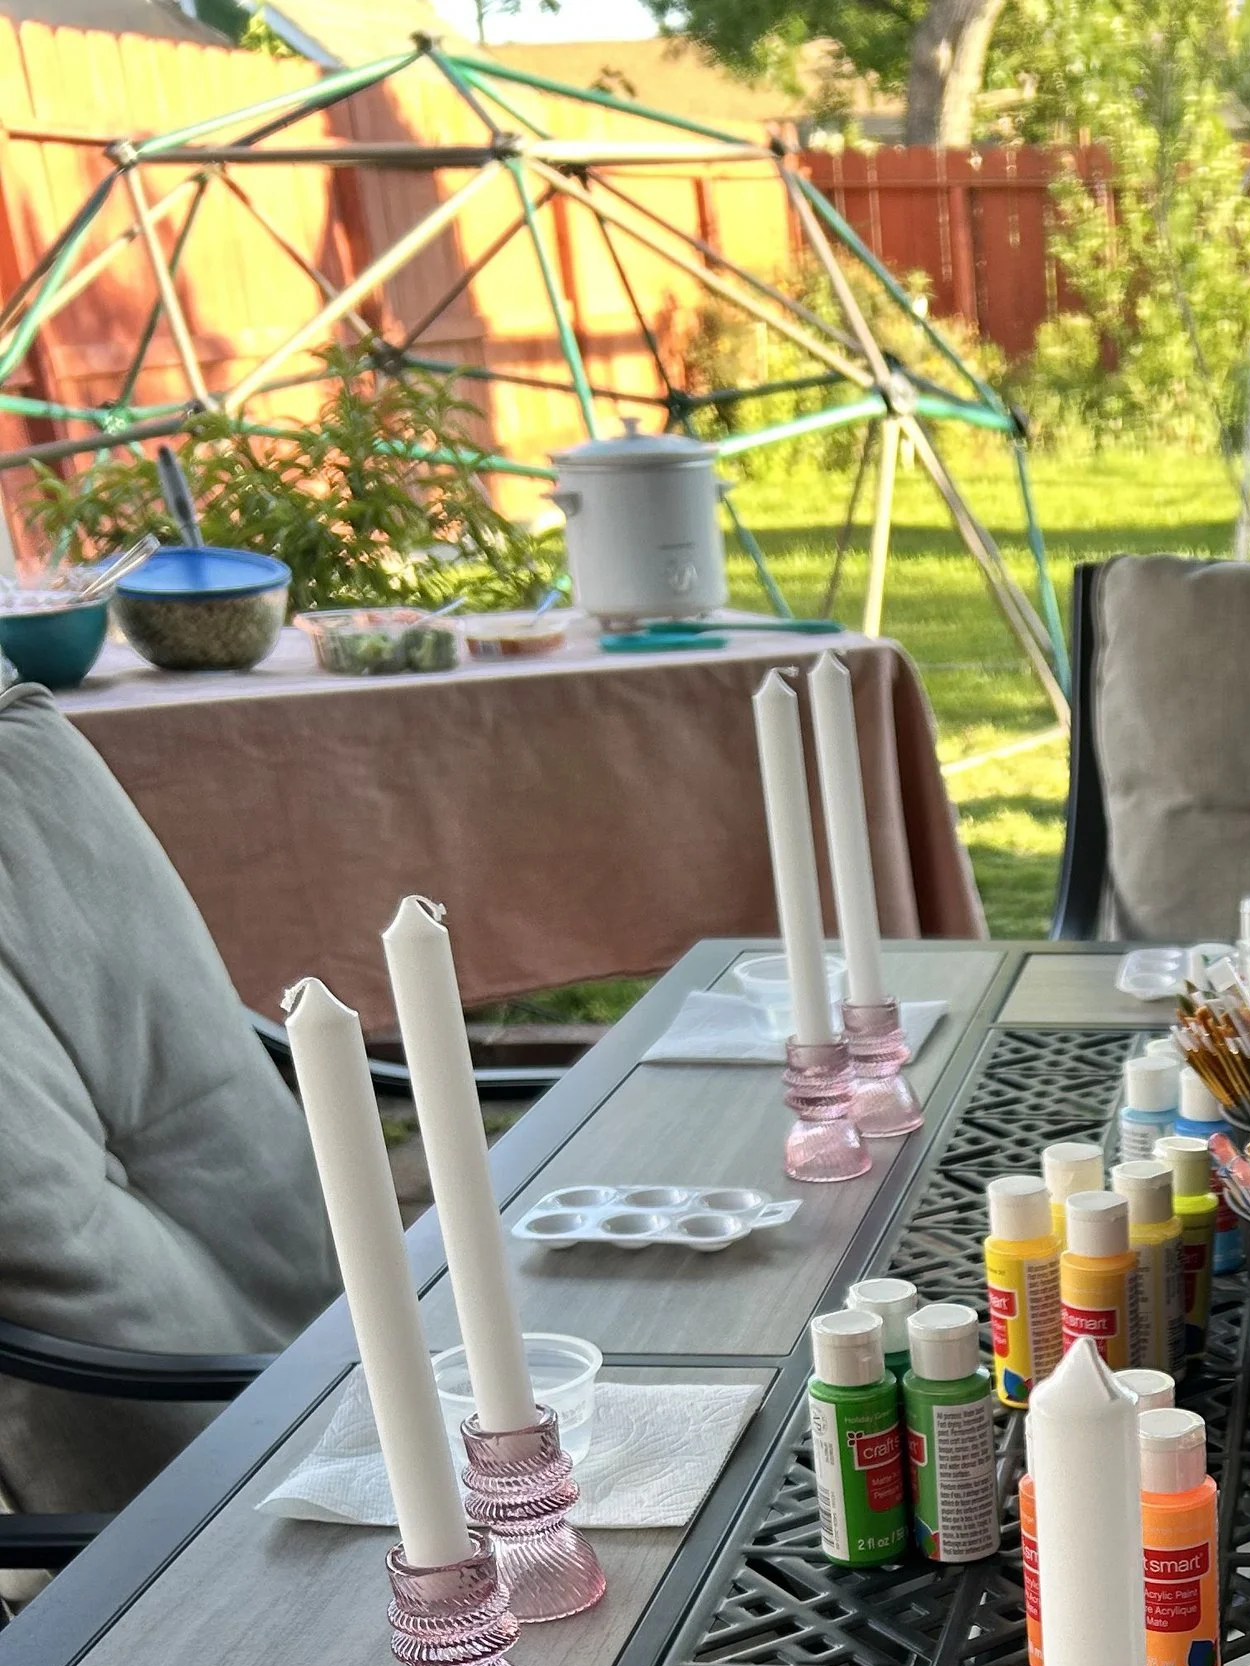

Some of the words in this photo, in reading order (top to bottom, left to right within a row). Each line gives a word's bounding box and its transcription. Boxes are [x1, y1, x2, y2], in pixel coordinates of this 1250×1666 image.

[863, 1438, 895, 1459] craft
[858, 1539, 865, 1550] 2
[867, 1538, 875, 1549] fl
[877, 1537, 889, 1547] oz
[1175, 1587, 1198, 1600] Paint
[1154, 1604, 1197, 1619] Acrylique
[1146, 1618, 1169, 1628] Mate
